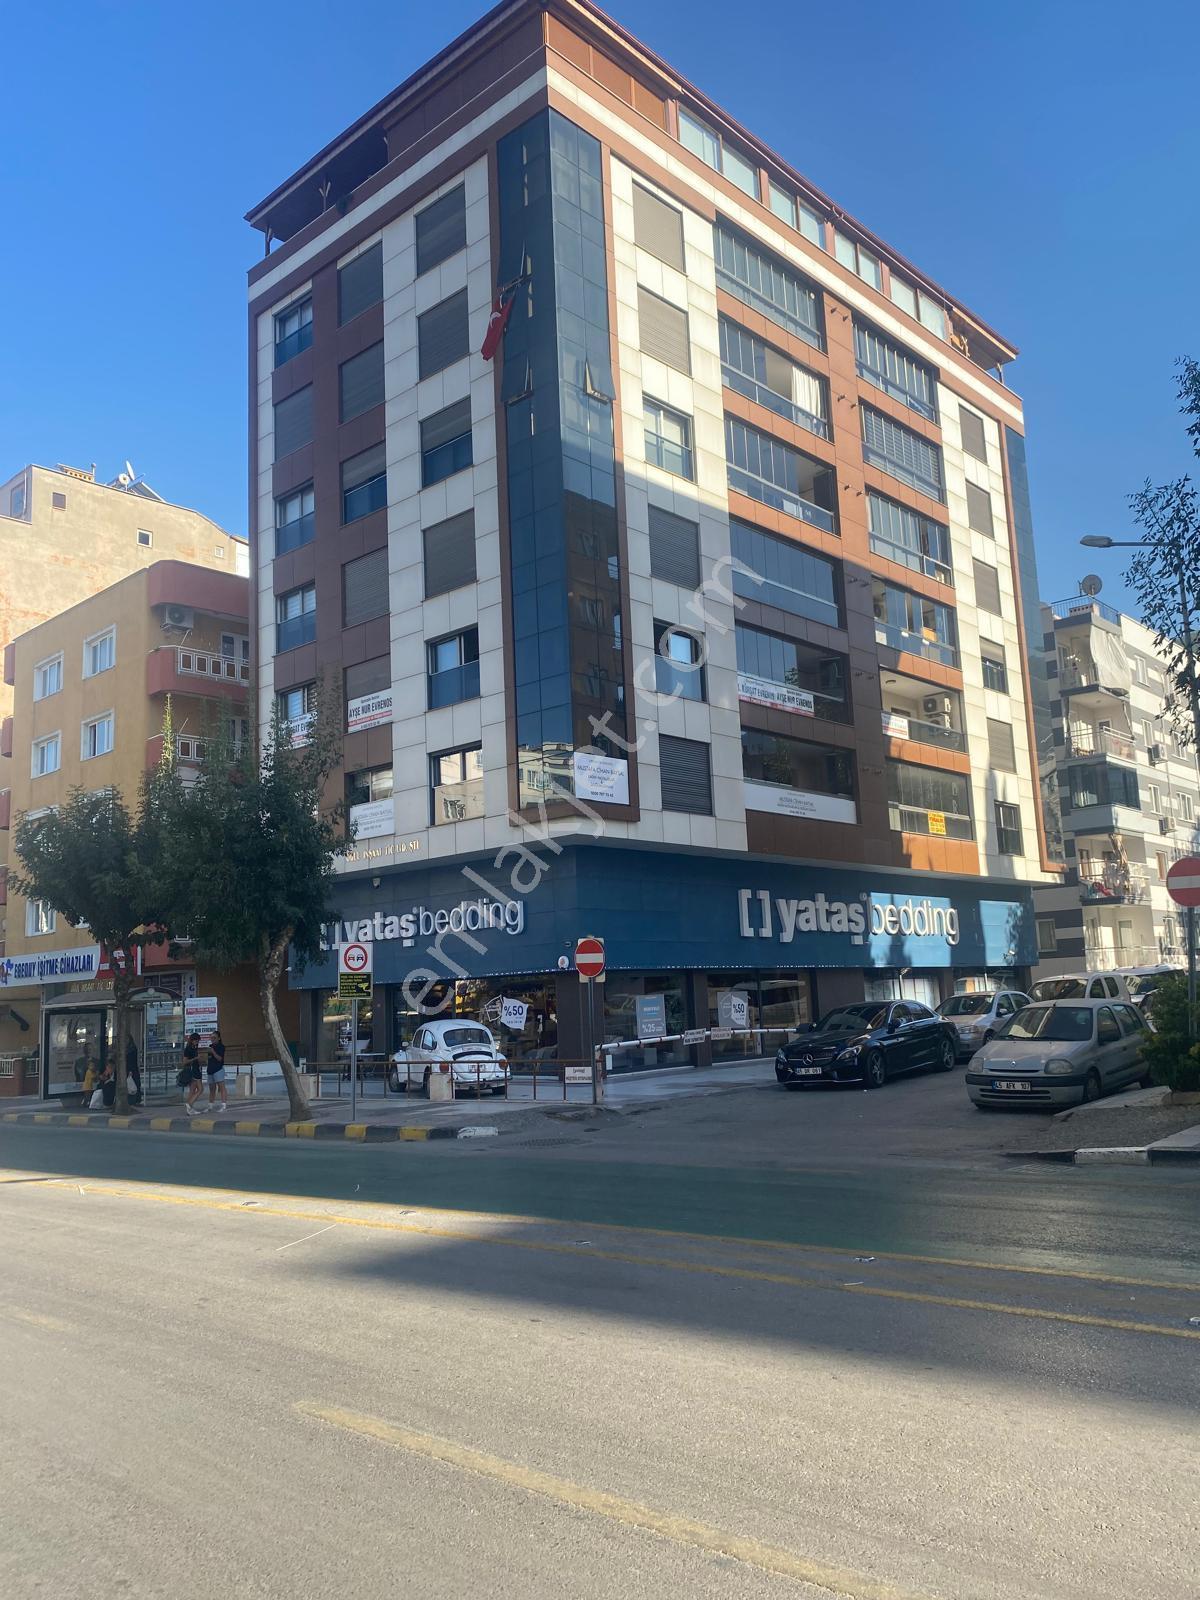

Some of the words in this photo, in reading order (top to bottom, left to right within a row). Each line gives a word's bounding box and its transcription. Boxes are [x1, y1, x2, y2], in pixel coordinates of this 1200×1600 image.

[349, 706, 361, 719] AYŞE
[361, 703, 371, 715] NUR
[372, 696, 393, 712] EVRENOS
[866, 896, 960, 945] bedding
[37, 956, 59, 980] İŞİTME
[60, 953, 94, 975] CİHAZLARI
[503, 1005, 524, 1017] %50
[732, 1003, 745, 1014] %50
[642, 1023, 656, 1034] %25
